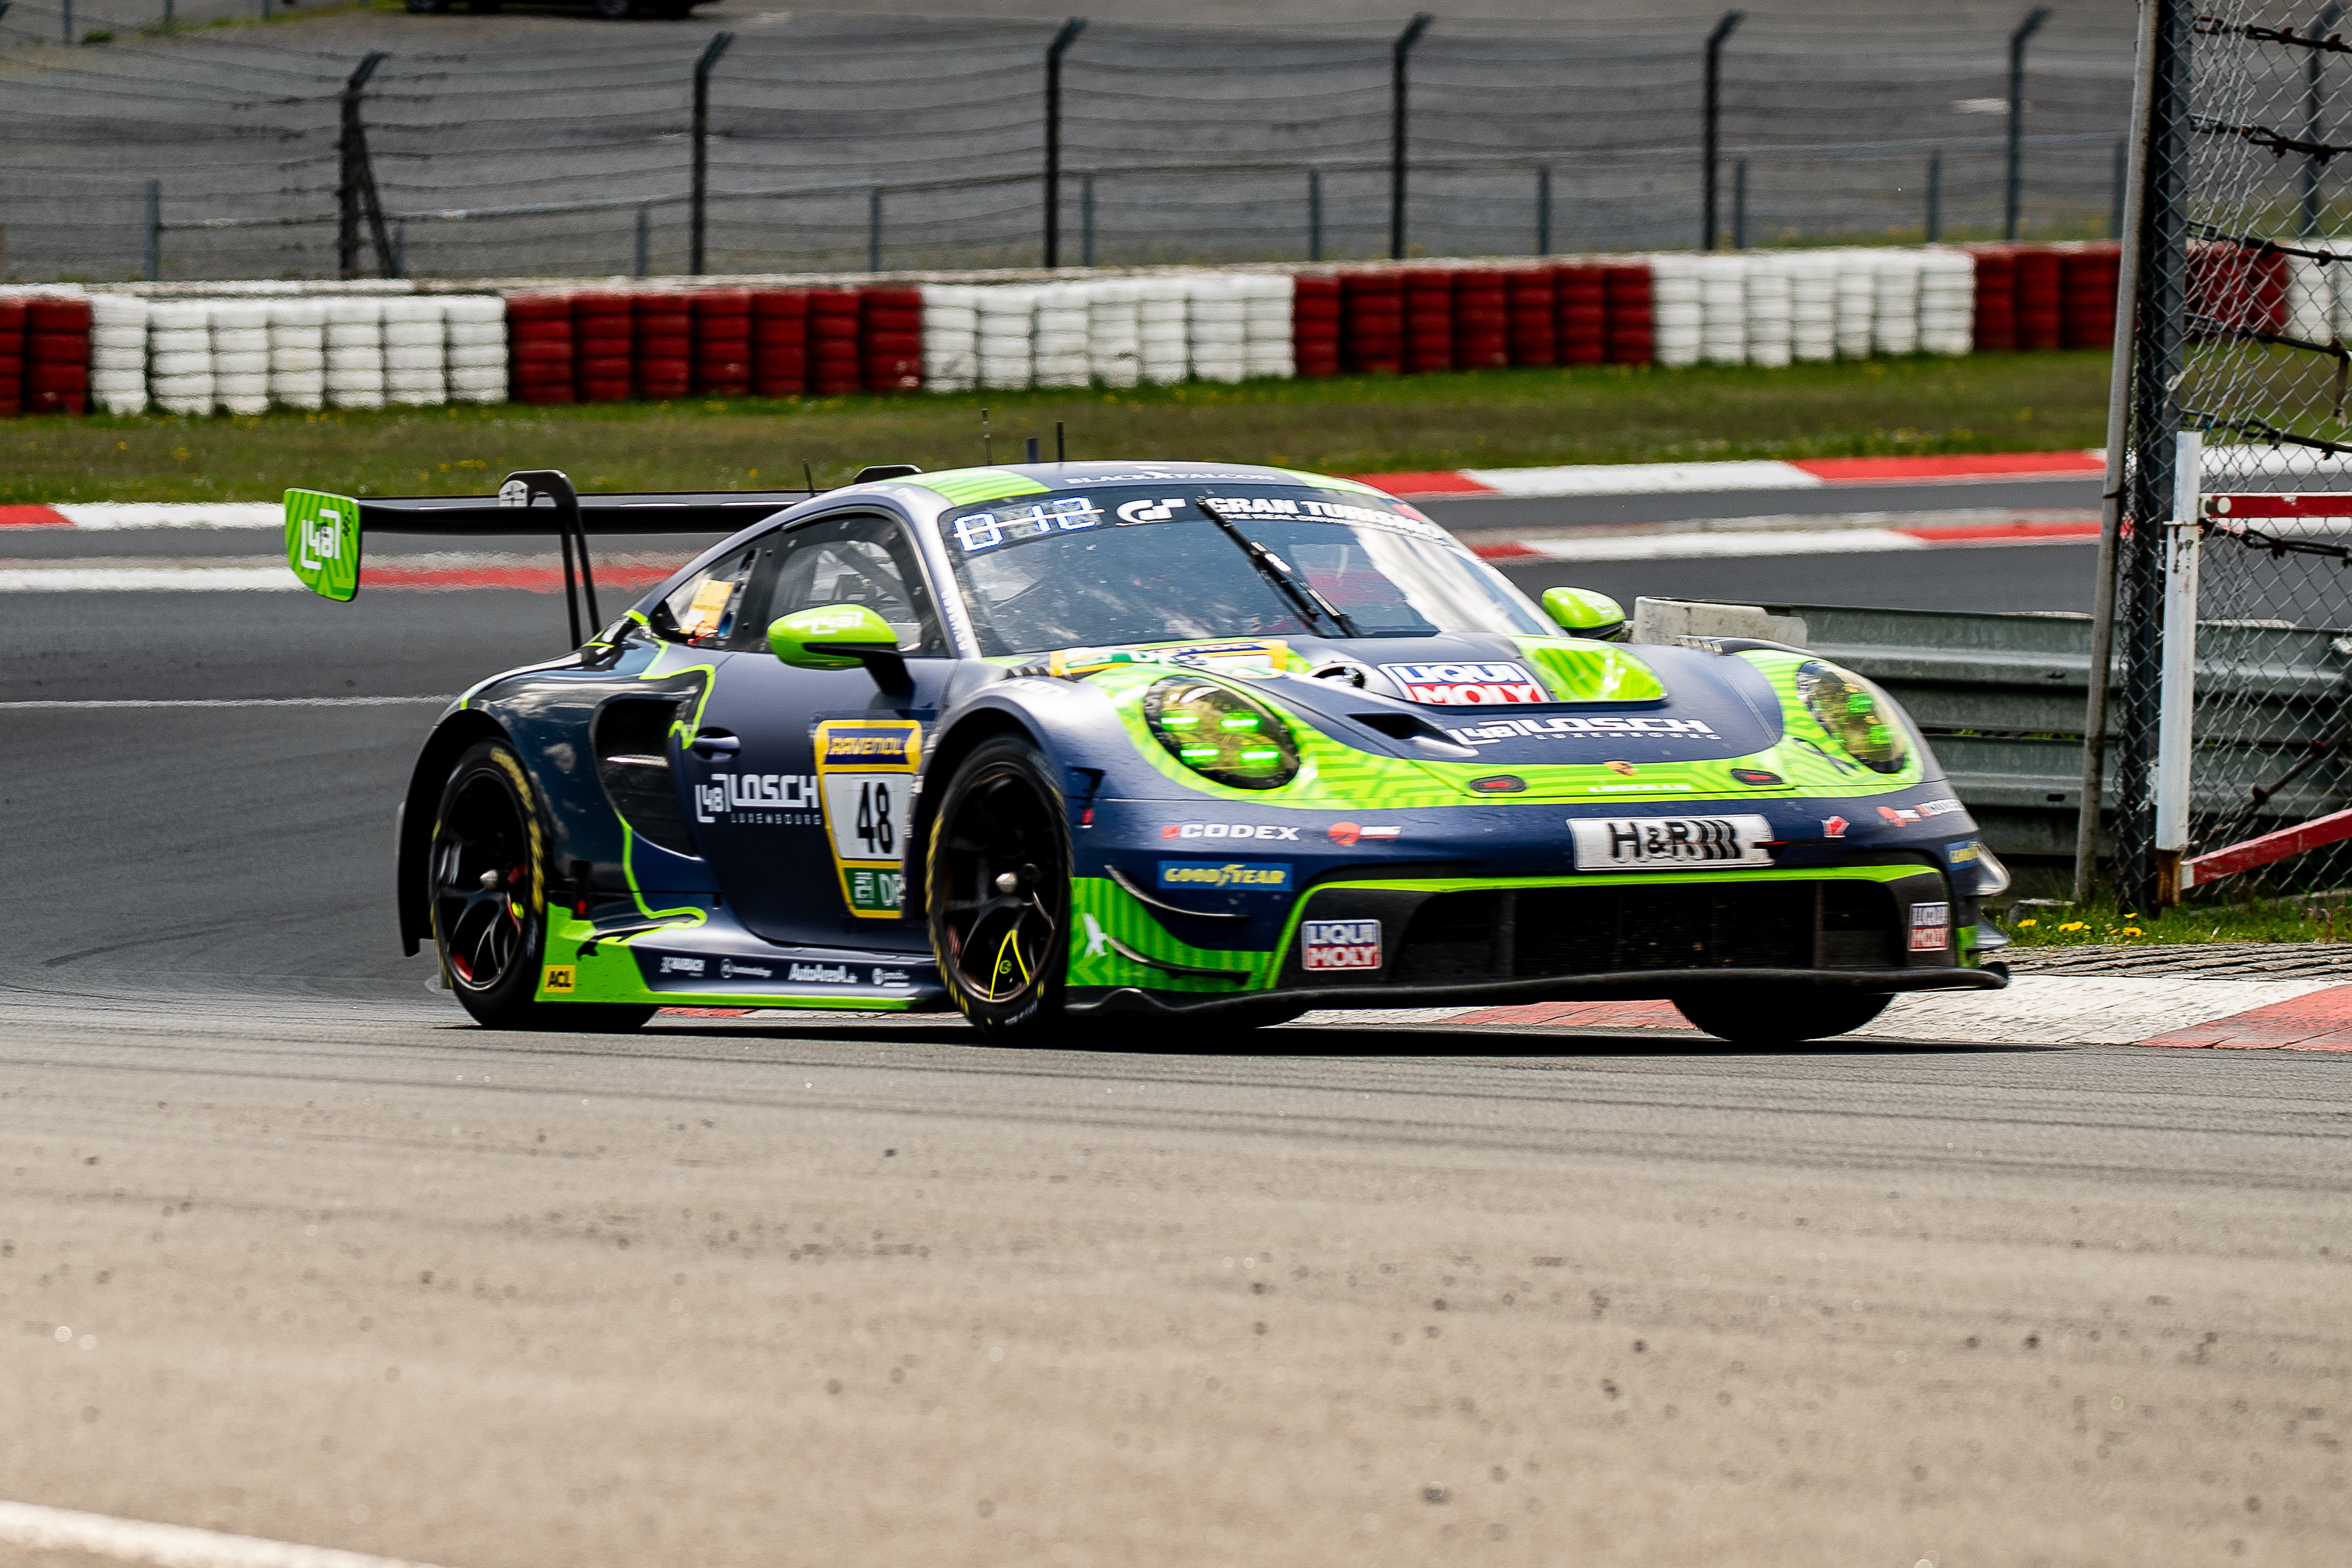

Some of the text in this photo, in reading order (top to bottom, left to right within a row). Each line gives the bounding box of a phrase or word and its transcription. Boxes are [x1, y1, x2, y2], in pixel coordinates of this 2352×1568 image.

[1065, 472, 1277, 484] BLACK FALCON
[1205, 497, 1300, 515] GRAN
[1300, 500, 1447, 539] TURISMO
[1390, 665, 1526, 684] LIQUI
[1411, 684, 1536, 704] MOLY
[1518, 717, 1715, 736] LOSCH
[829, 737, 903, 755] RAVENOL
[1535, 732, 1722, 741] LUXEMBOURG
[730, 774, 820, 808] LOSCH
[856, 781, 893, 855] 48
[1180, 824, 1301, 841] CODEX
[1164, 863, 1286, 887] GOODYEAR
[1308, 924, 1375, 944] LIQUI
[1308, 947, 1378, 966] MOLY
[547, 971, 572, 987] ACL
